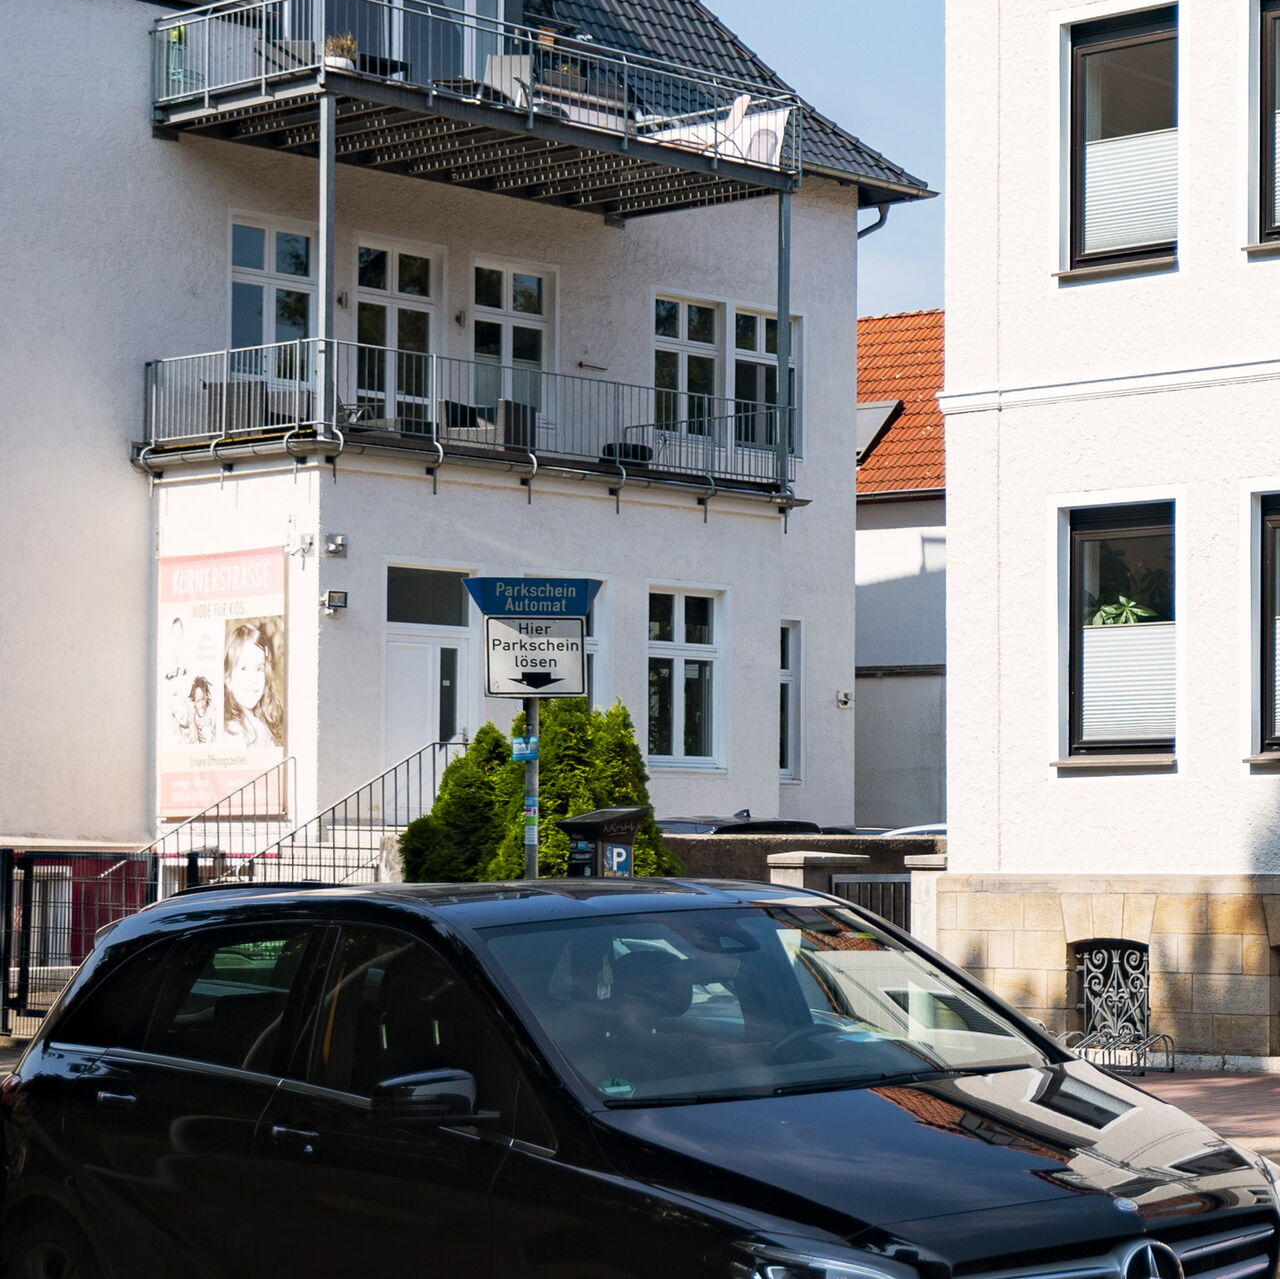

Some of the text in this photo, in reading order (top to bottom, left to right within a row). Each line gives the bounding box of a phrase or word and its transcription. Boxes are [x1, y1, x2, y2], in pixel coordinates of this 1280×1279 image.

[495, 582, 576, 598] Parkschein
[505, 598, 567, 612] Automat
[518, 623, 552, 635] Hier
[492, 639, 579, 652] Parkschein
[515, 655, 557, 668] lösen
[613, 848, 627, 872] P
